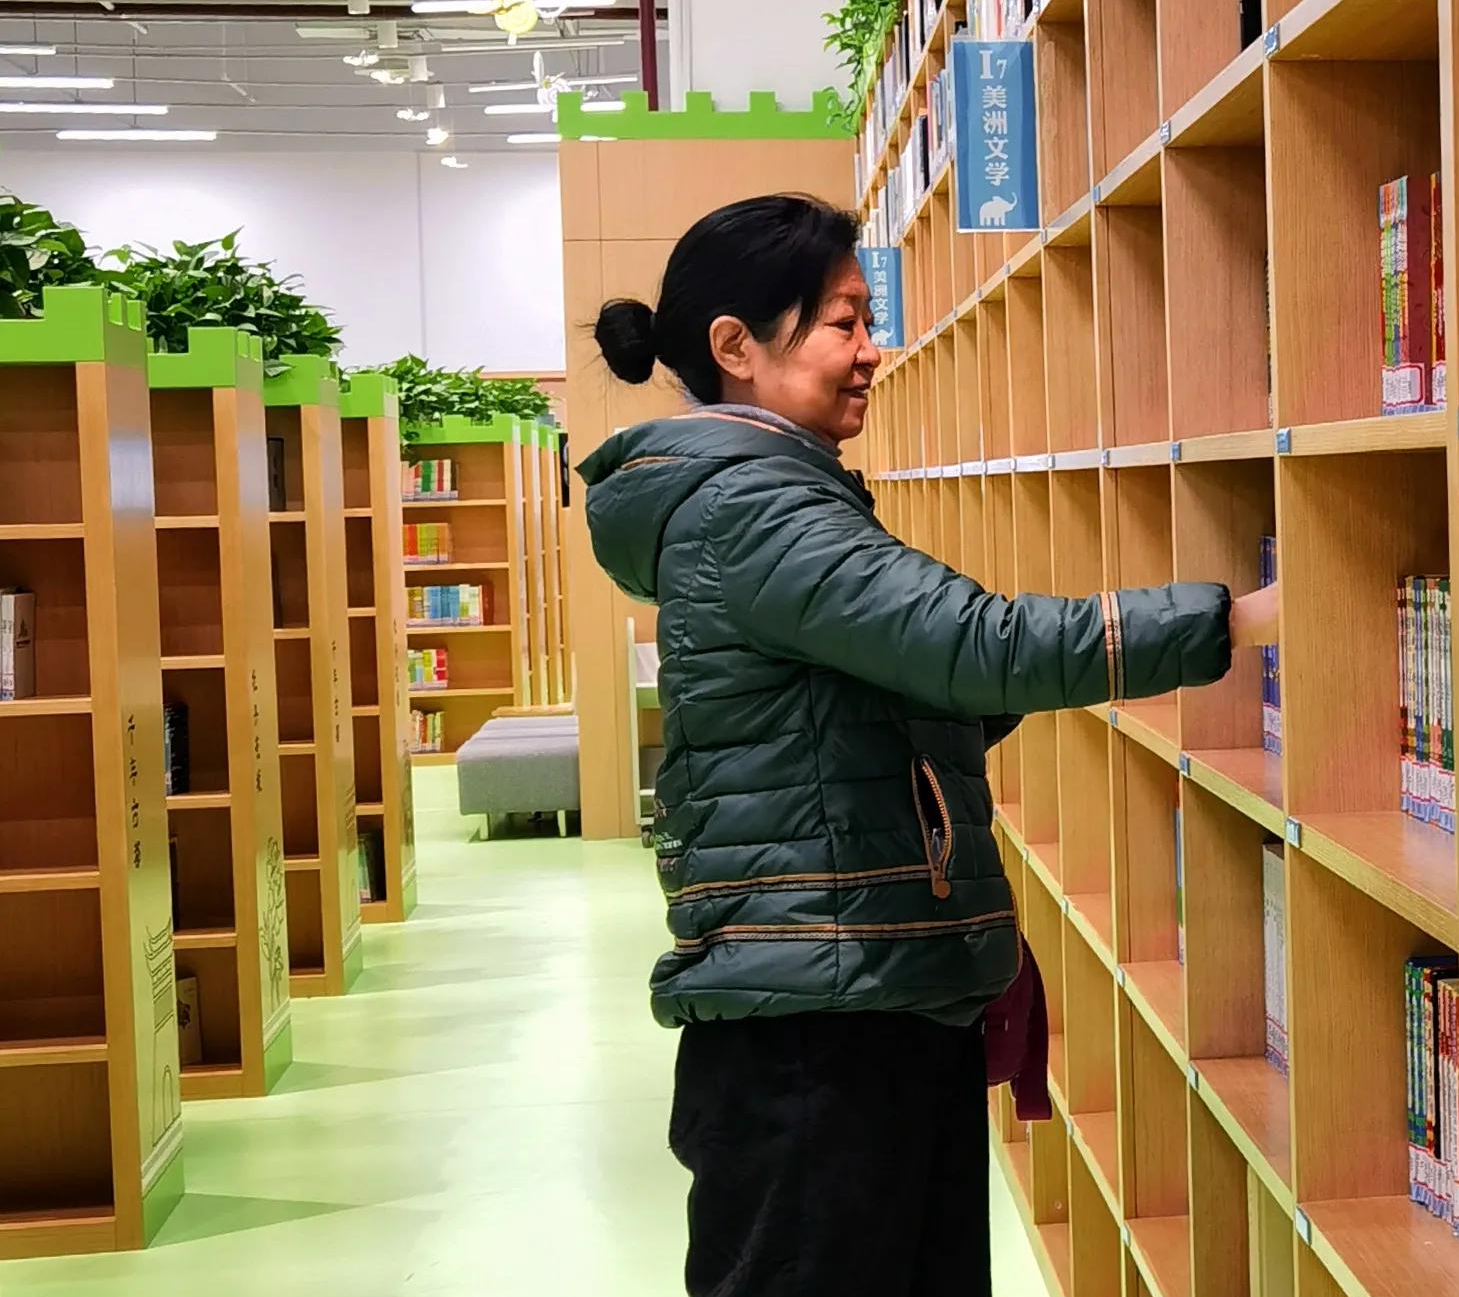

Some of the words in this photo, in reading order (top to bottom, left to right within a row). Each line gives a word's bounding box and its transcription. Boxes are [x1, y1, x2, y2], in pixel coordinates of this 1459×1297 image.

[979, 50, 1007, 80] I7
[981, 83, 1010, 187] 美洲文学
